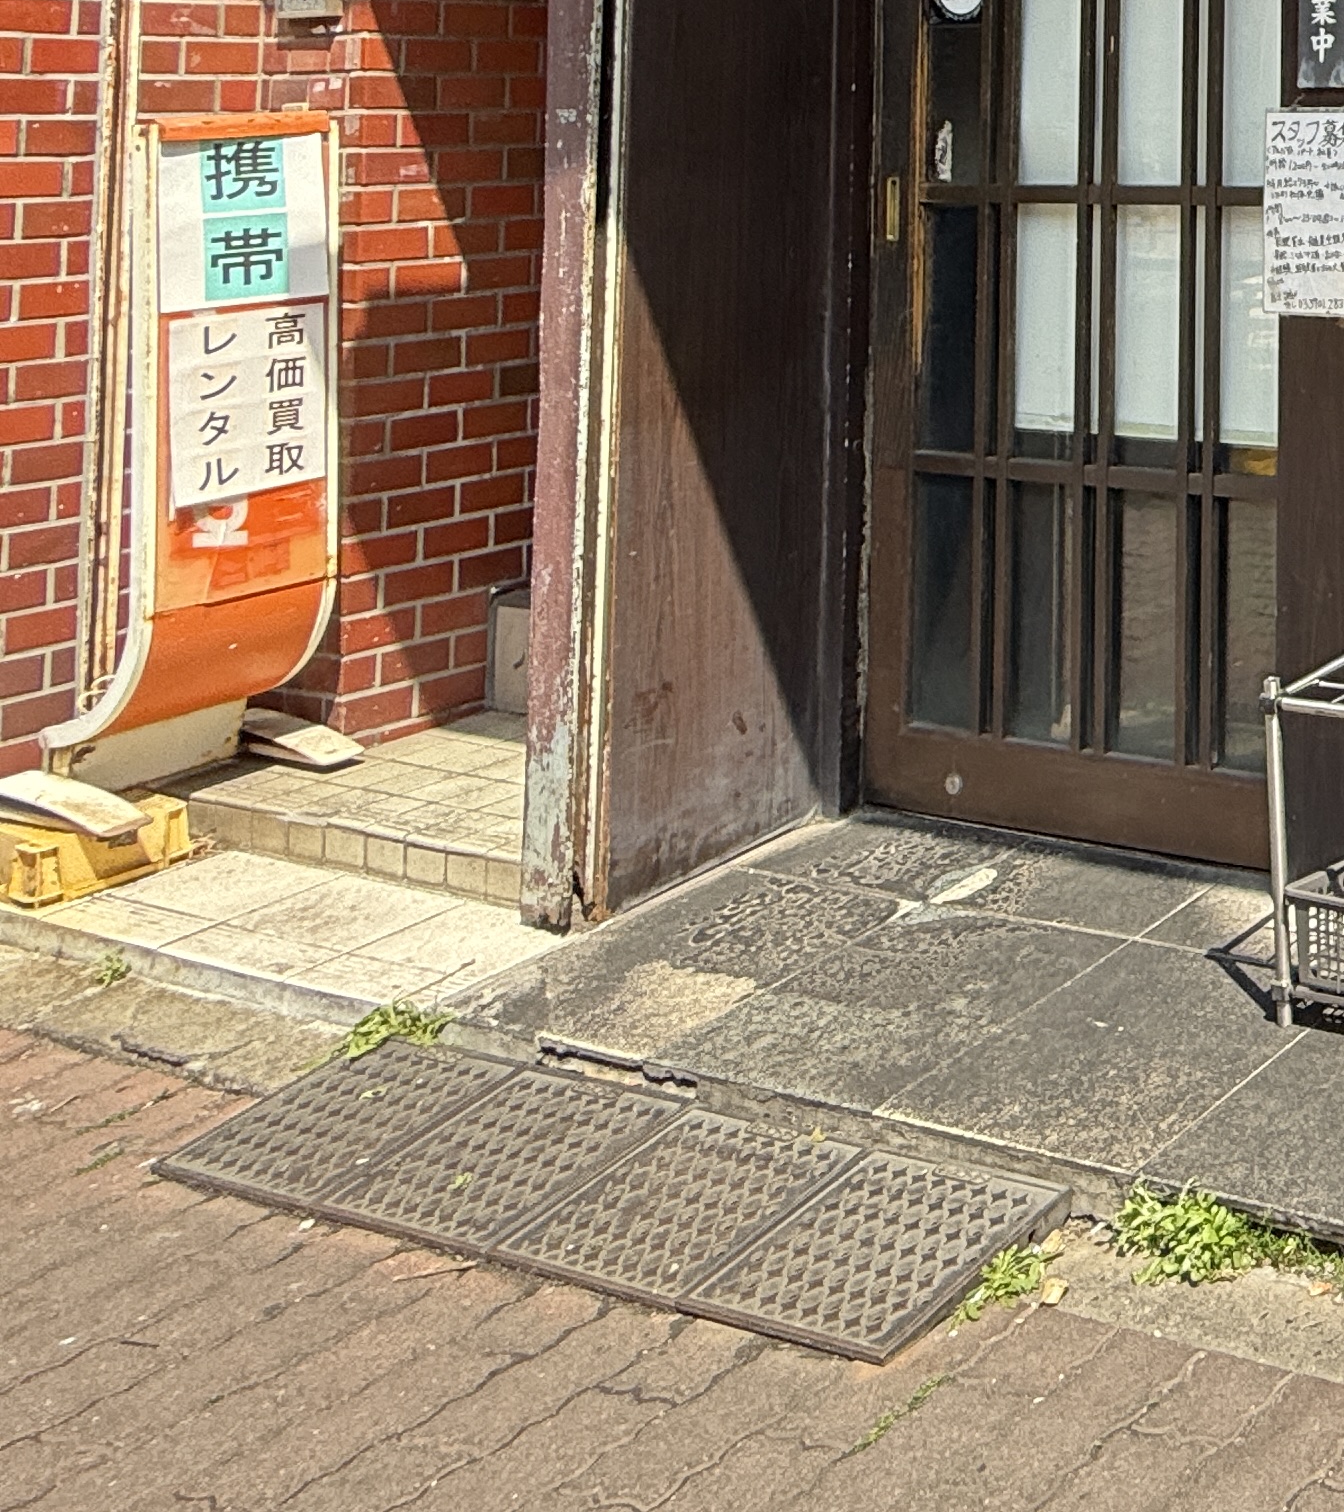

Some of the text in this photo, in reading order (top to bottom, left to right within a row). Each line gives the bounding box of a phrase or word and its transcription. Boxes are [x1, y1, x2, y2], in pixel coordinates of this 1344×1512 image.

[204, 140, 284, 287] 携帯
[198, 324, 239, 492] レンタル
[265, 311, 306, 476] 高価買取
